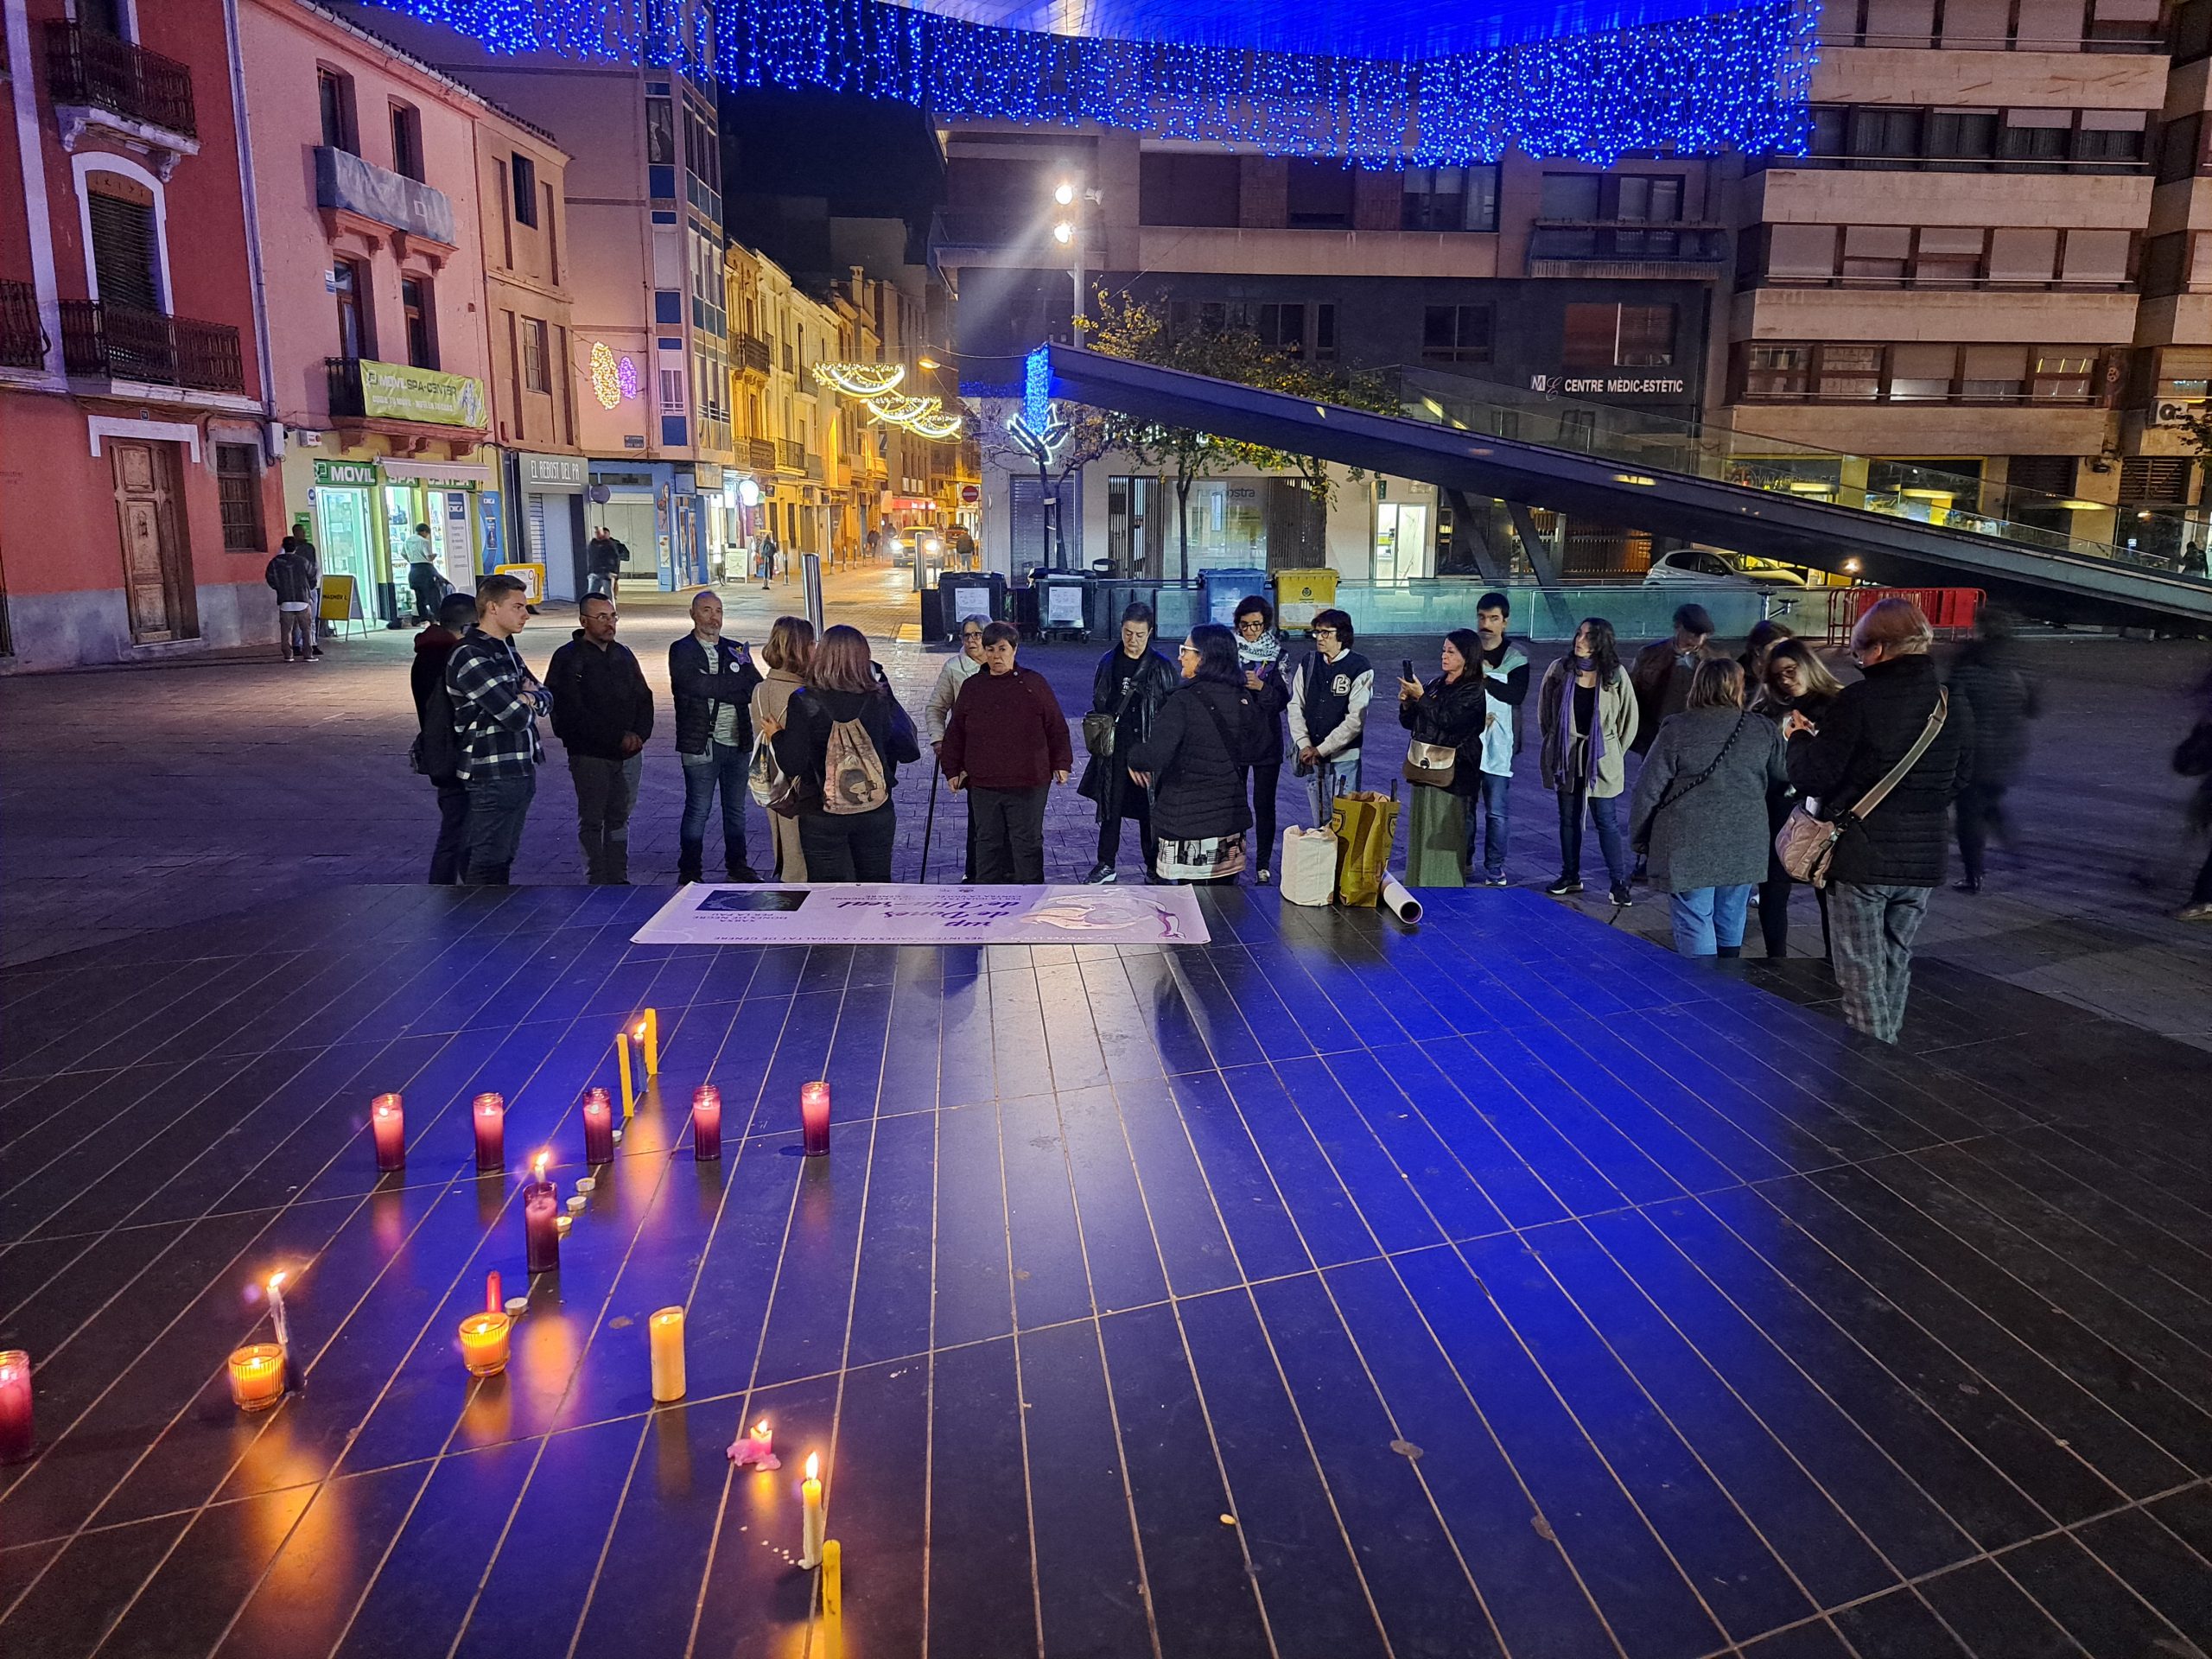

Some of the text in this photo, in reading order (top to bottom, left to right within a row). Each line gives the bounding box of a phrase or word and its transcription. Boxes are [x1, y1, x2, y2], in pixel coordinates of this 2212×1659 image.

[1565, 379, 1604, 392] CENTRE
[1607, 376, 1684, 392] MÈDIC-ESTÈTIC
[330, 466, 376, 483] MOVIL
[531, 461, 580, 480] EL REBOST DEL PA
